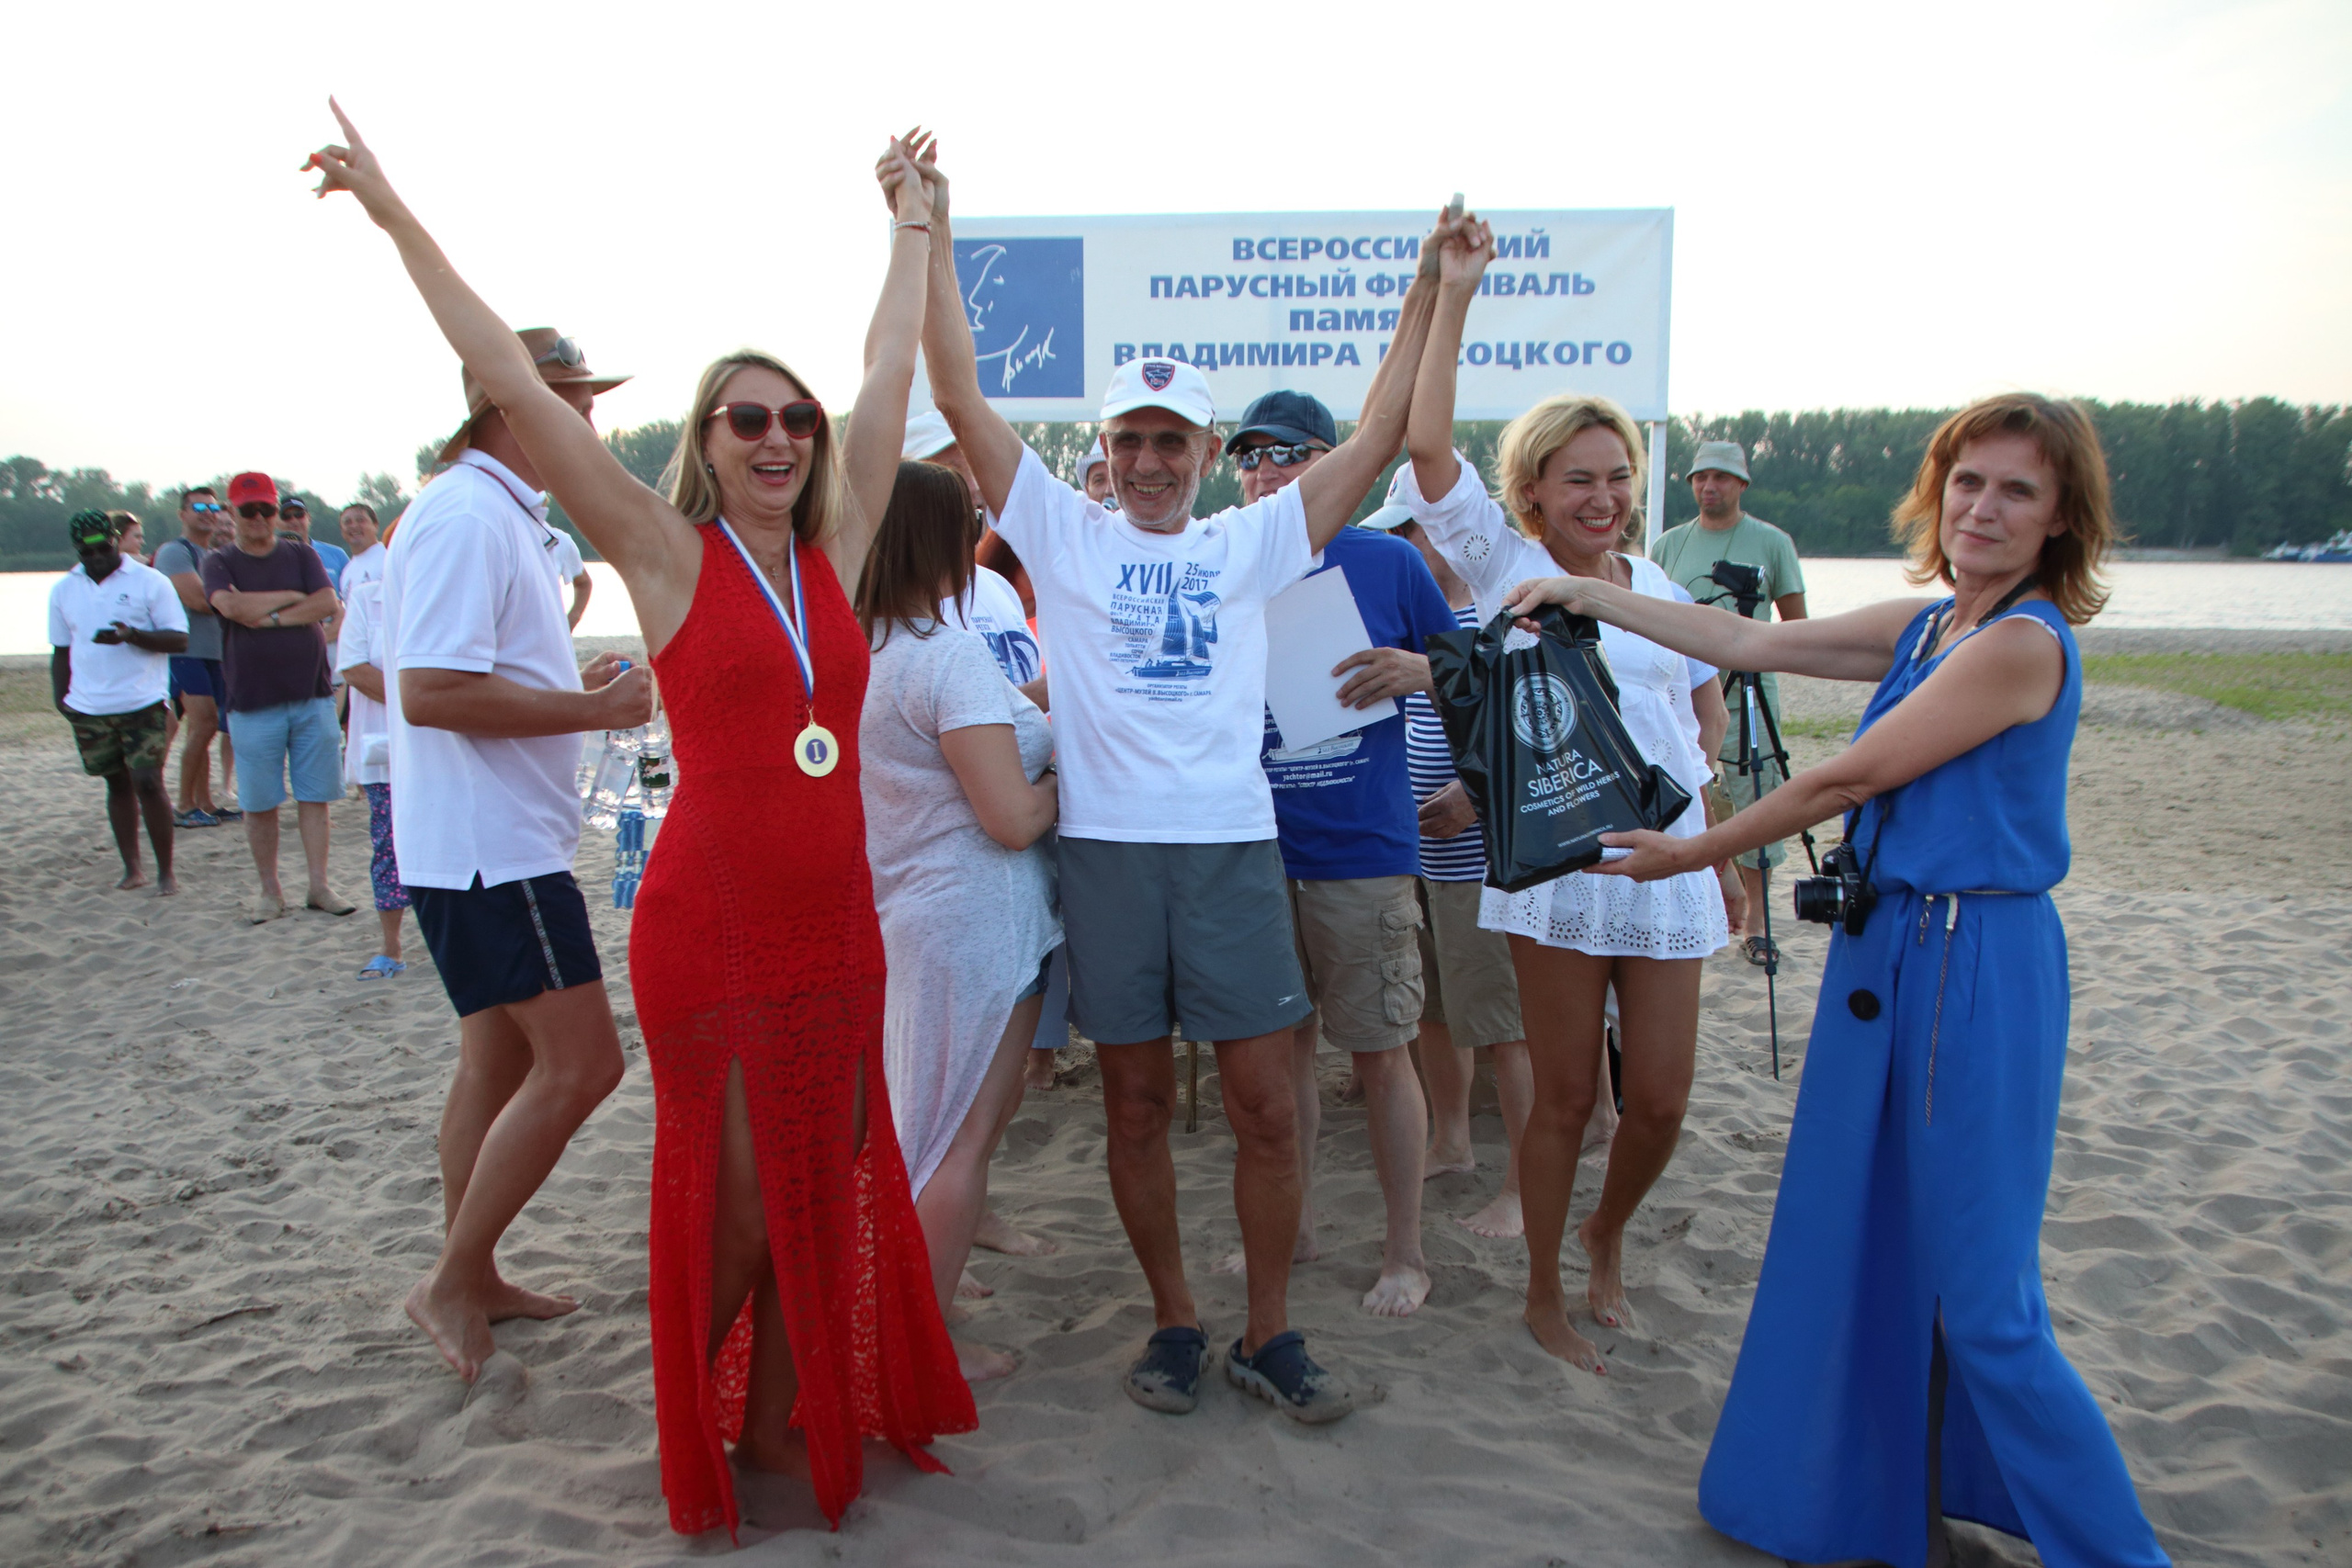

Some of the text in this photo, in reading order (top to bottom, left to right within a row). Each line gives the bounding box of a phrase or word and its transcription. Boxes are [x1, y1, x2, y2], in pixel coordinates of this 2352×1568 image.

[1232, 227, 1550, 262] ВСЕРОССИИЙ
[1149, 266, 1356, 299] ПАРУСНЫЙ
[1289, 308, 1401, 331] памя
[1114, 342, 1361, 371] ВЛАДИМИРА
[1115, 561, 1173, 595] XVII
[1181, 576, 1208, 592] 2017
[1110, 602, 1163, 615] ПАРУСНАЯ
[1113, 593, 1165, 605] ВСЕРОССИЙСКАЯ
[1111, 626, 1153, 636] ВЫСОЦКОГО
[1535, 749, 1582, 775] NATURA
[1283, 771, 1333, 782] yachtor@mail.ru
[1528, 759, 1603, 798] SIBERICA
[1521, 771, 1621, 814] COSMETICS OF WILD HERBS
[1547, 790, 1600, 817] AND FLOWERS
